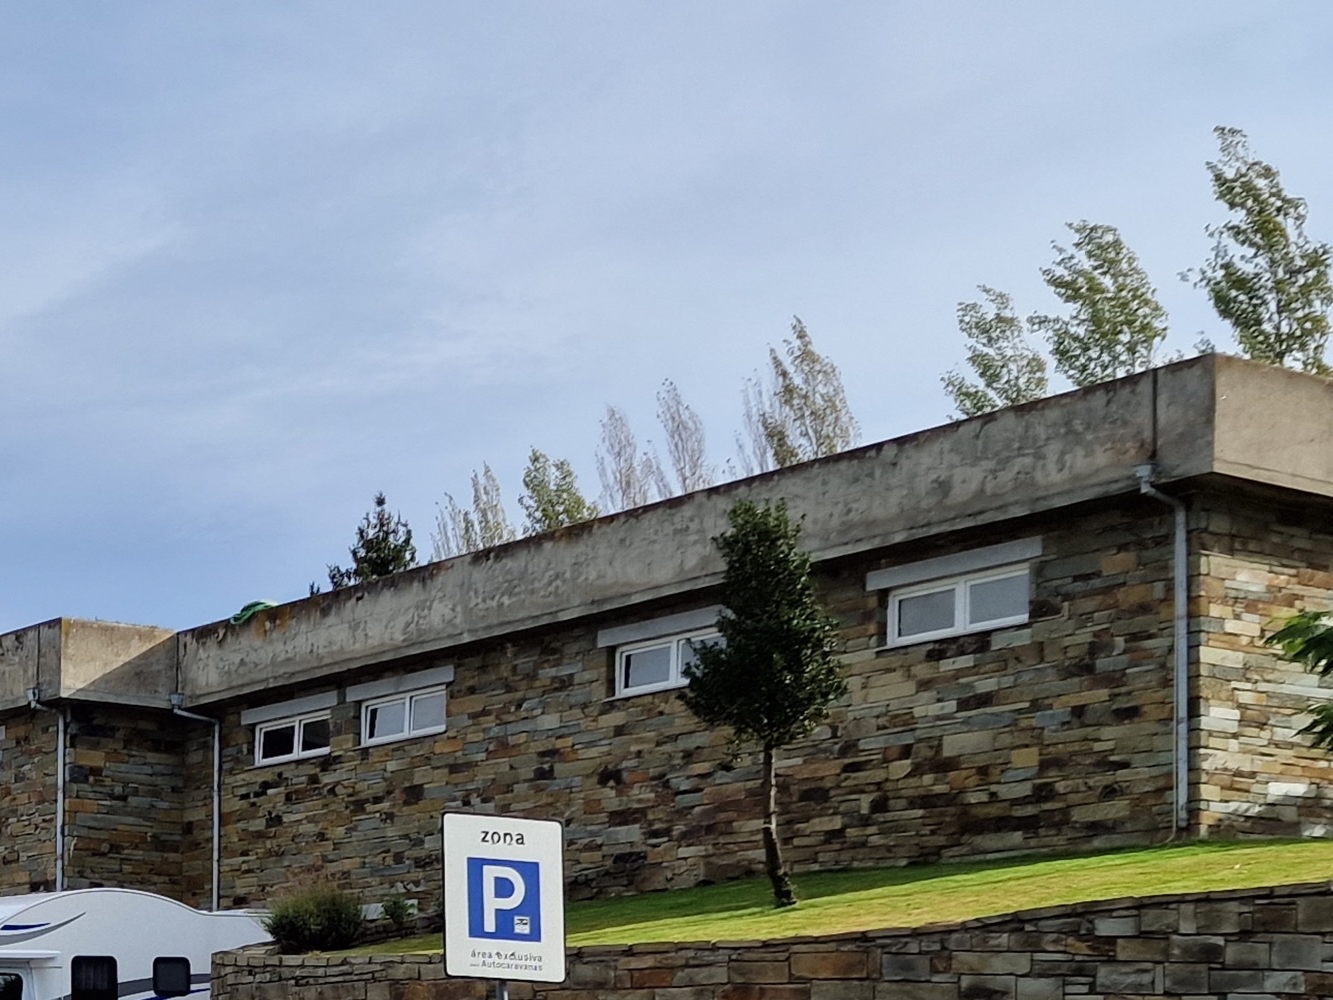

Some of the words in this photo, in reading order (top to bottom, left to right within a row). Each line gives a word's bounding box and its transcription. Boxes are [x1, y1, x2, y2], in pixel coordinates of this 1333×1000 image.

[480, 830, 525, 846] zona
[482, 864, 526, 933] P
[470, 948, 493, 959] área
[494, 950, 543, 962] exclusiva
